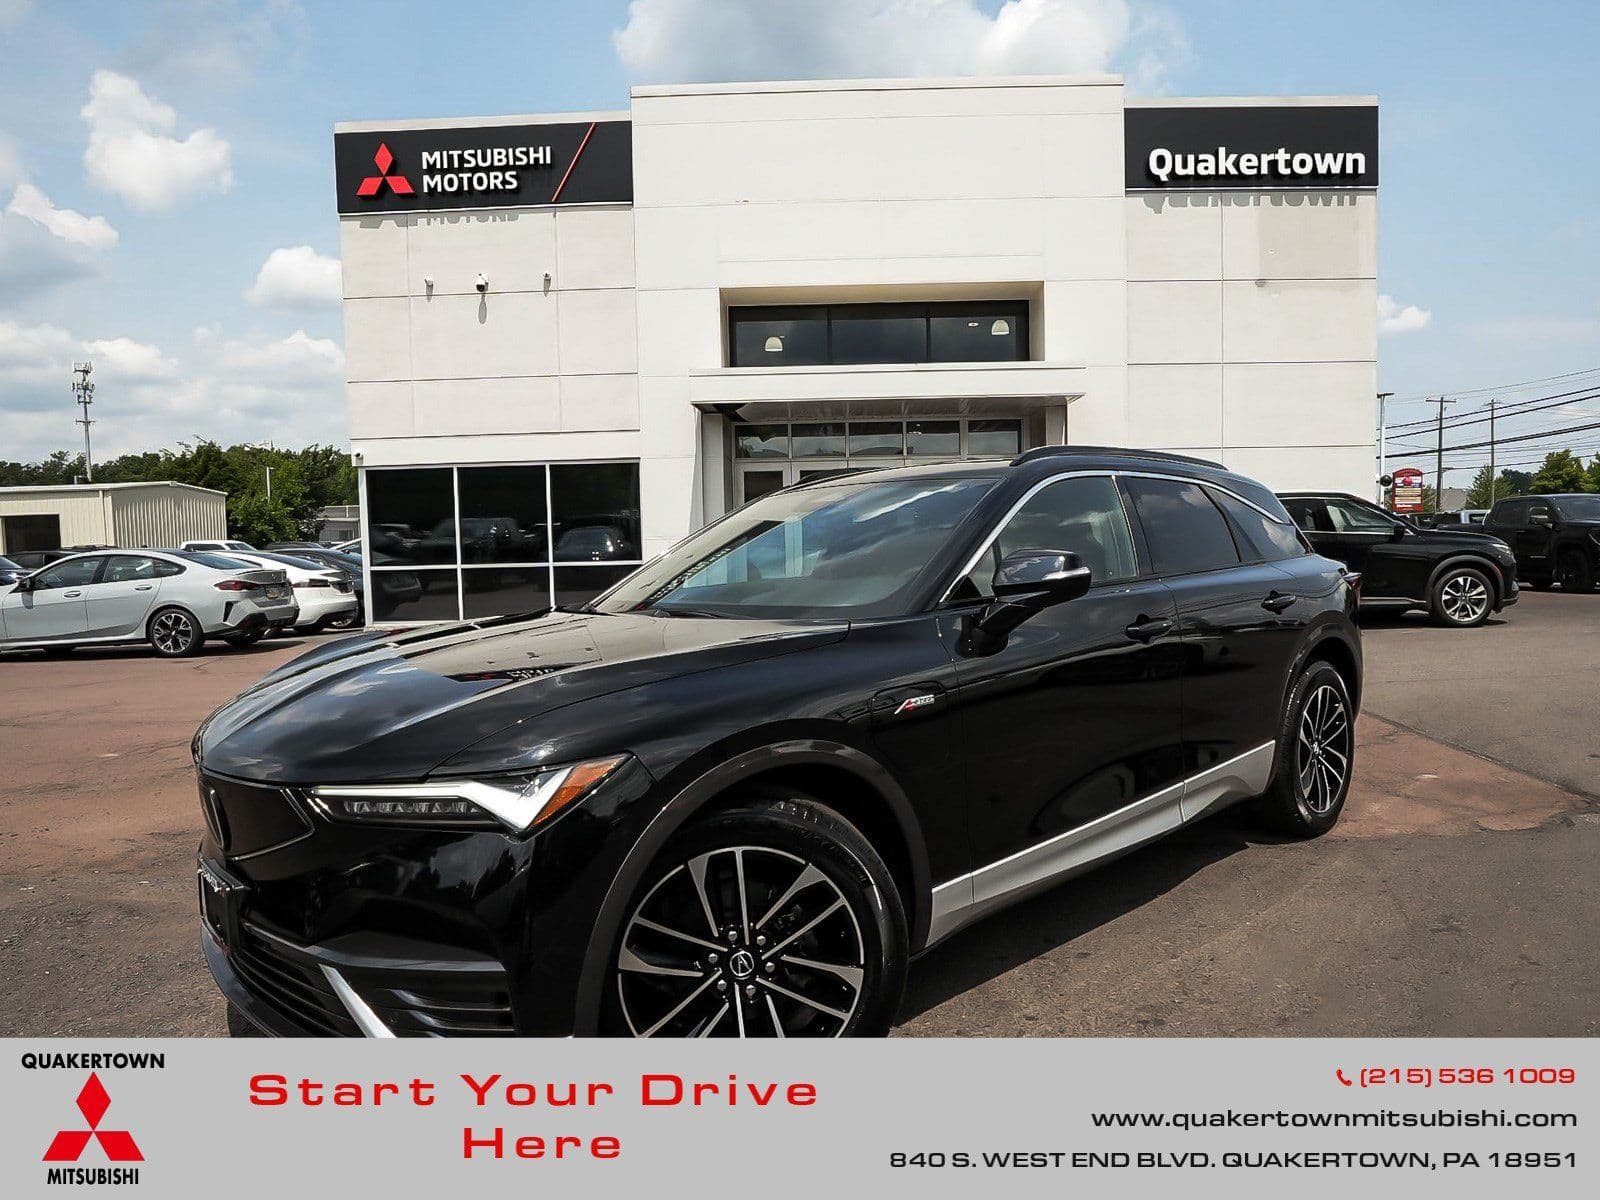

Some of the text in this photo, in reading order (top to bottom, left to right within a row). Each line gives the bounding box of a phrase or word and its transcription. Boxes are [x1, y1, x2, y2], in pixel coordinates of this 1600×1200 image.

[421, 146, 552, 170] MITSUBISHI
[1149, 146, 1366, 182] Quakertown
[422, 171, 518, 193] MOTORS
